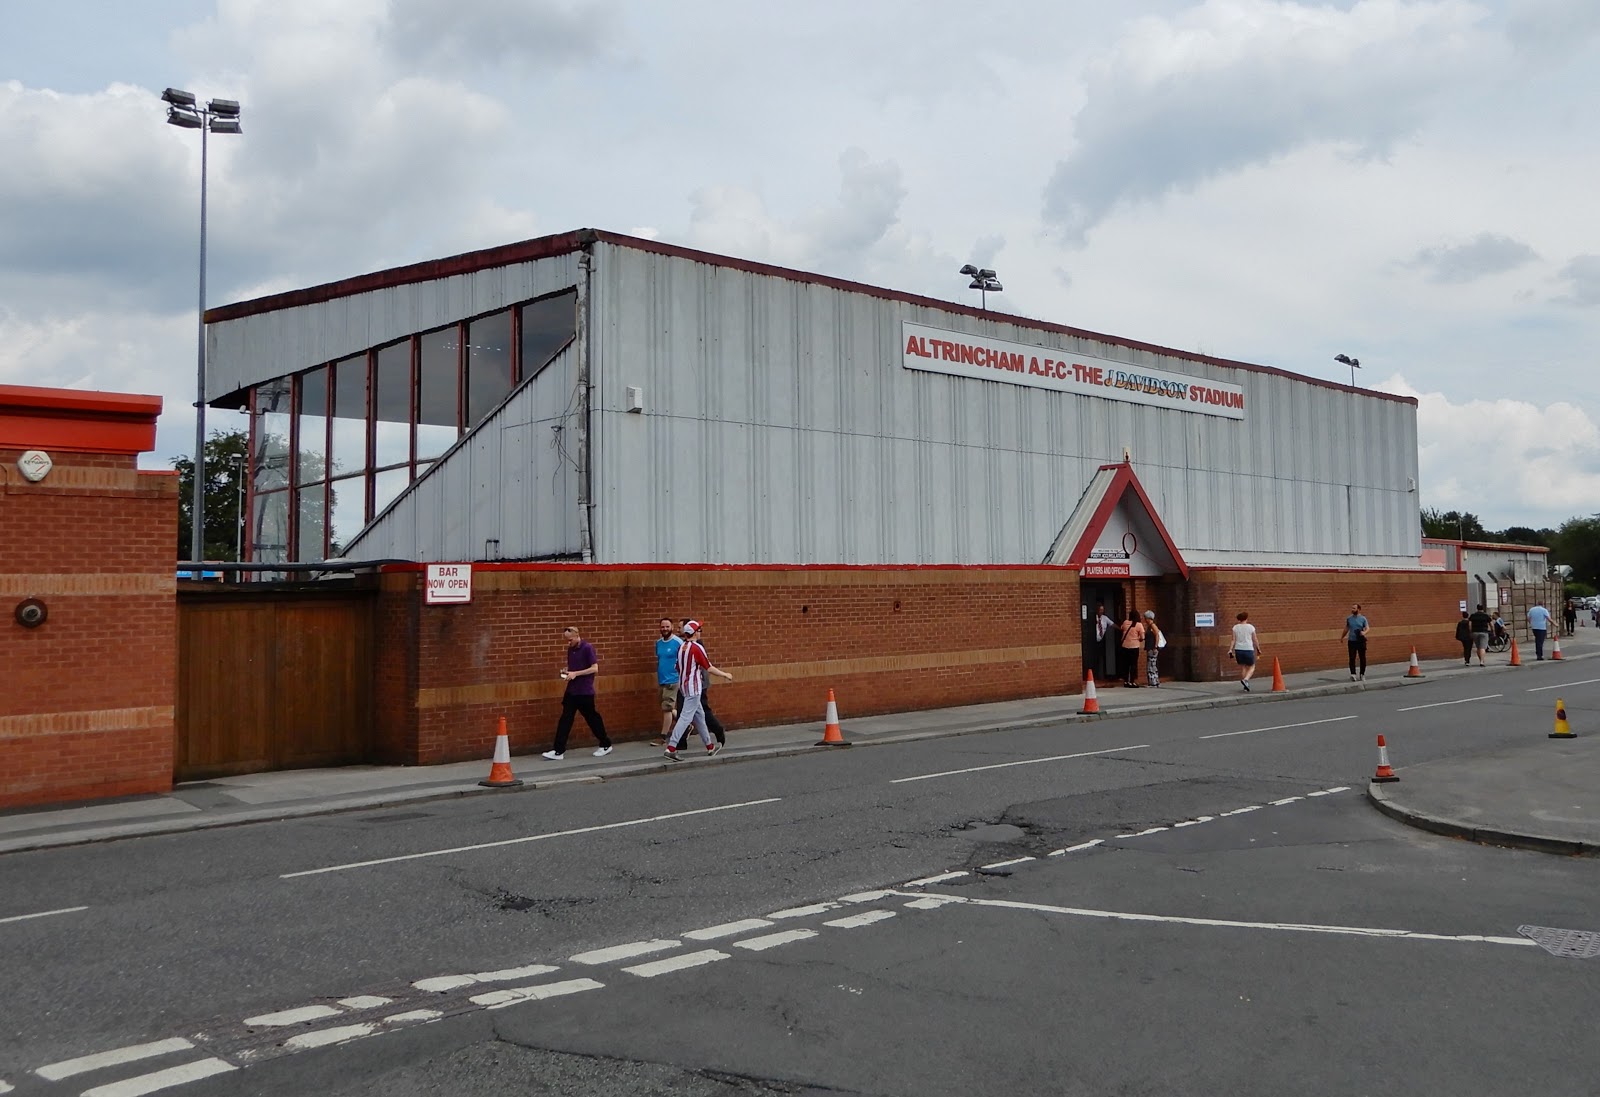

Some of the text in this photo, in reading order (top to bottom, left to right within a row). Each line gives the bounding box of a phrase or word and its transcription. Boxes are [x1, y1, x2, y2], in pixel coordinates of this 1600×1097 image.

[906, 335, 1025, 373] ALTRINCHAM
[1115, 371, 1189, 400] DAVIDSON
[1189, 385, 1244, 409] STADIUM
[439, 567, 458, 577] BAR
[1086, 566, 1103, 575] PLAYERS
[1111, 566, 1129, 575] OFFICIALS
[428, 579, 469, 589] NOW OPEN
